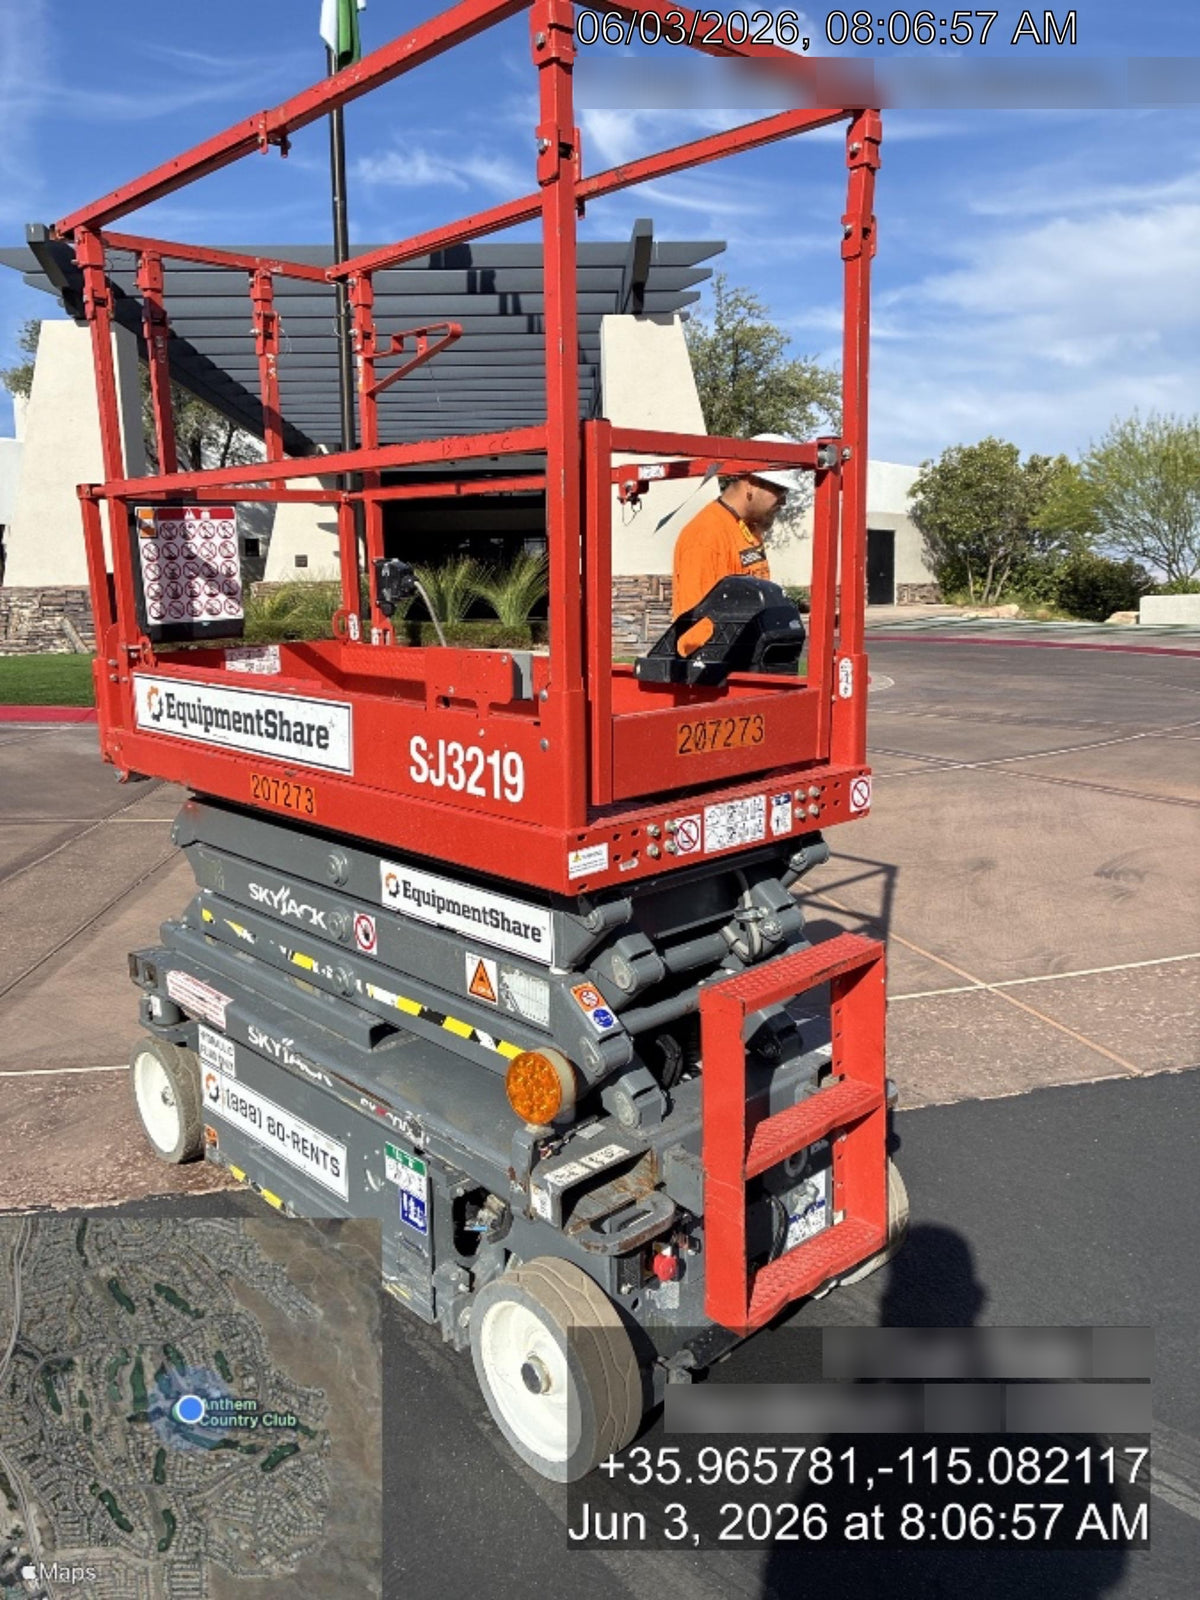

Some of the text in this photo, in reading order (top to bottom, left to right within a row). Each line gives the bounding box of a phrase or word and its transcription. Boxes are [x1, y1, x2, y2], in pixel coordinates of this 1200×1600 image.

[164, 692, 330, 750] EquipmentShare
[677, 715, 765, 754] 207273
[251, 773, 316, 814] 207273
[409, 735, 525, 803] SJ3219
[401, 879, 542, 943] EquipmentShare
[226, 1088, 262, 1129] (888)
[266, 1115, 341, 1178] 80-RENTS
